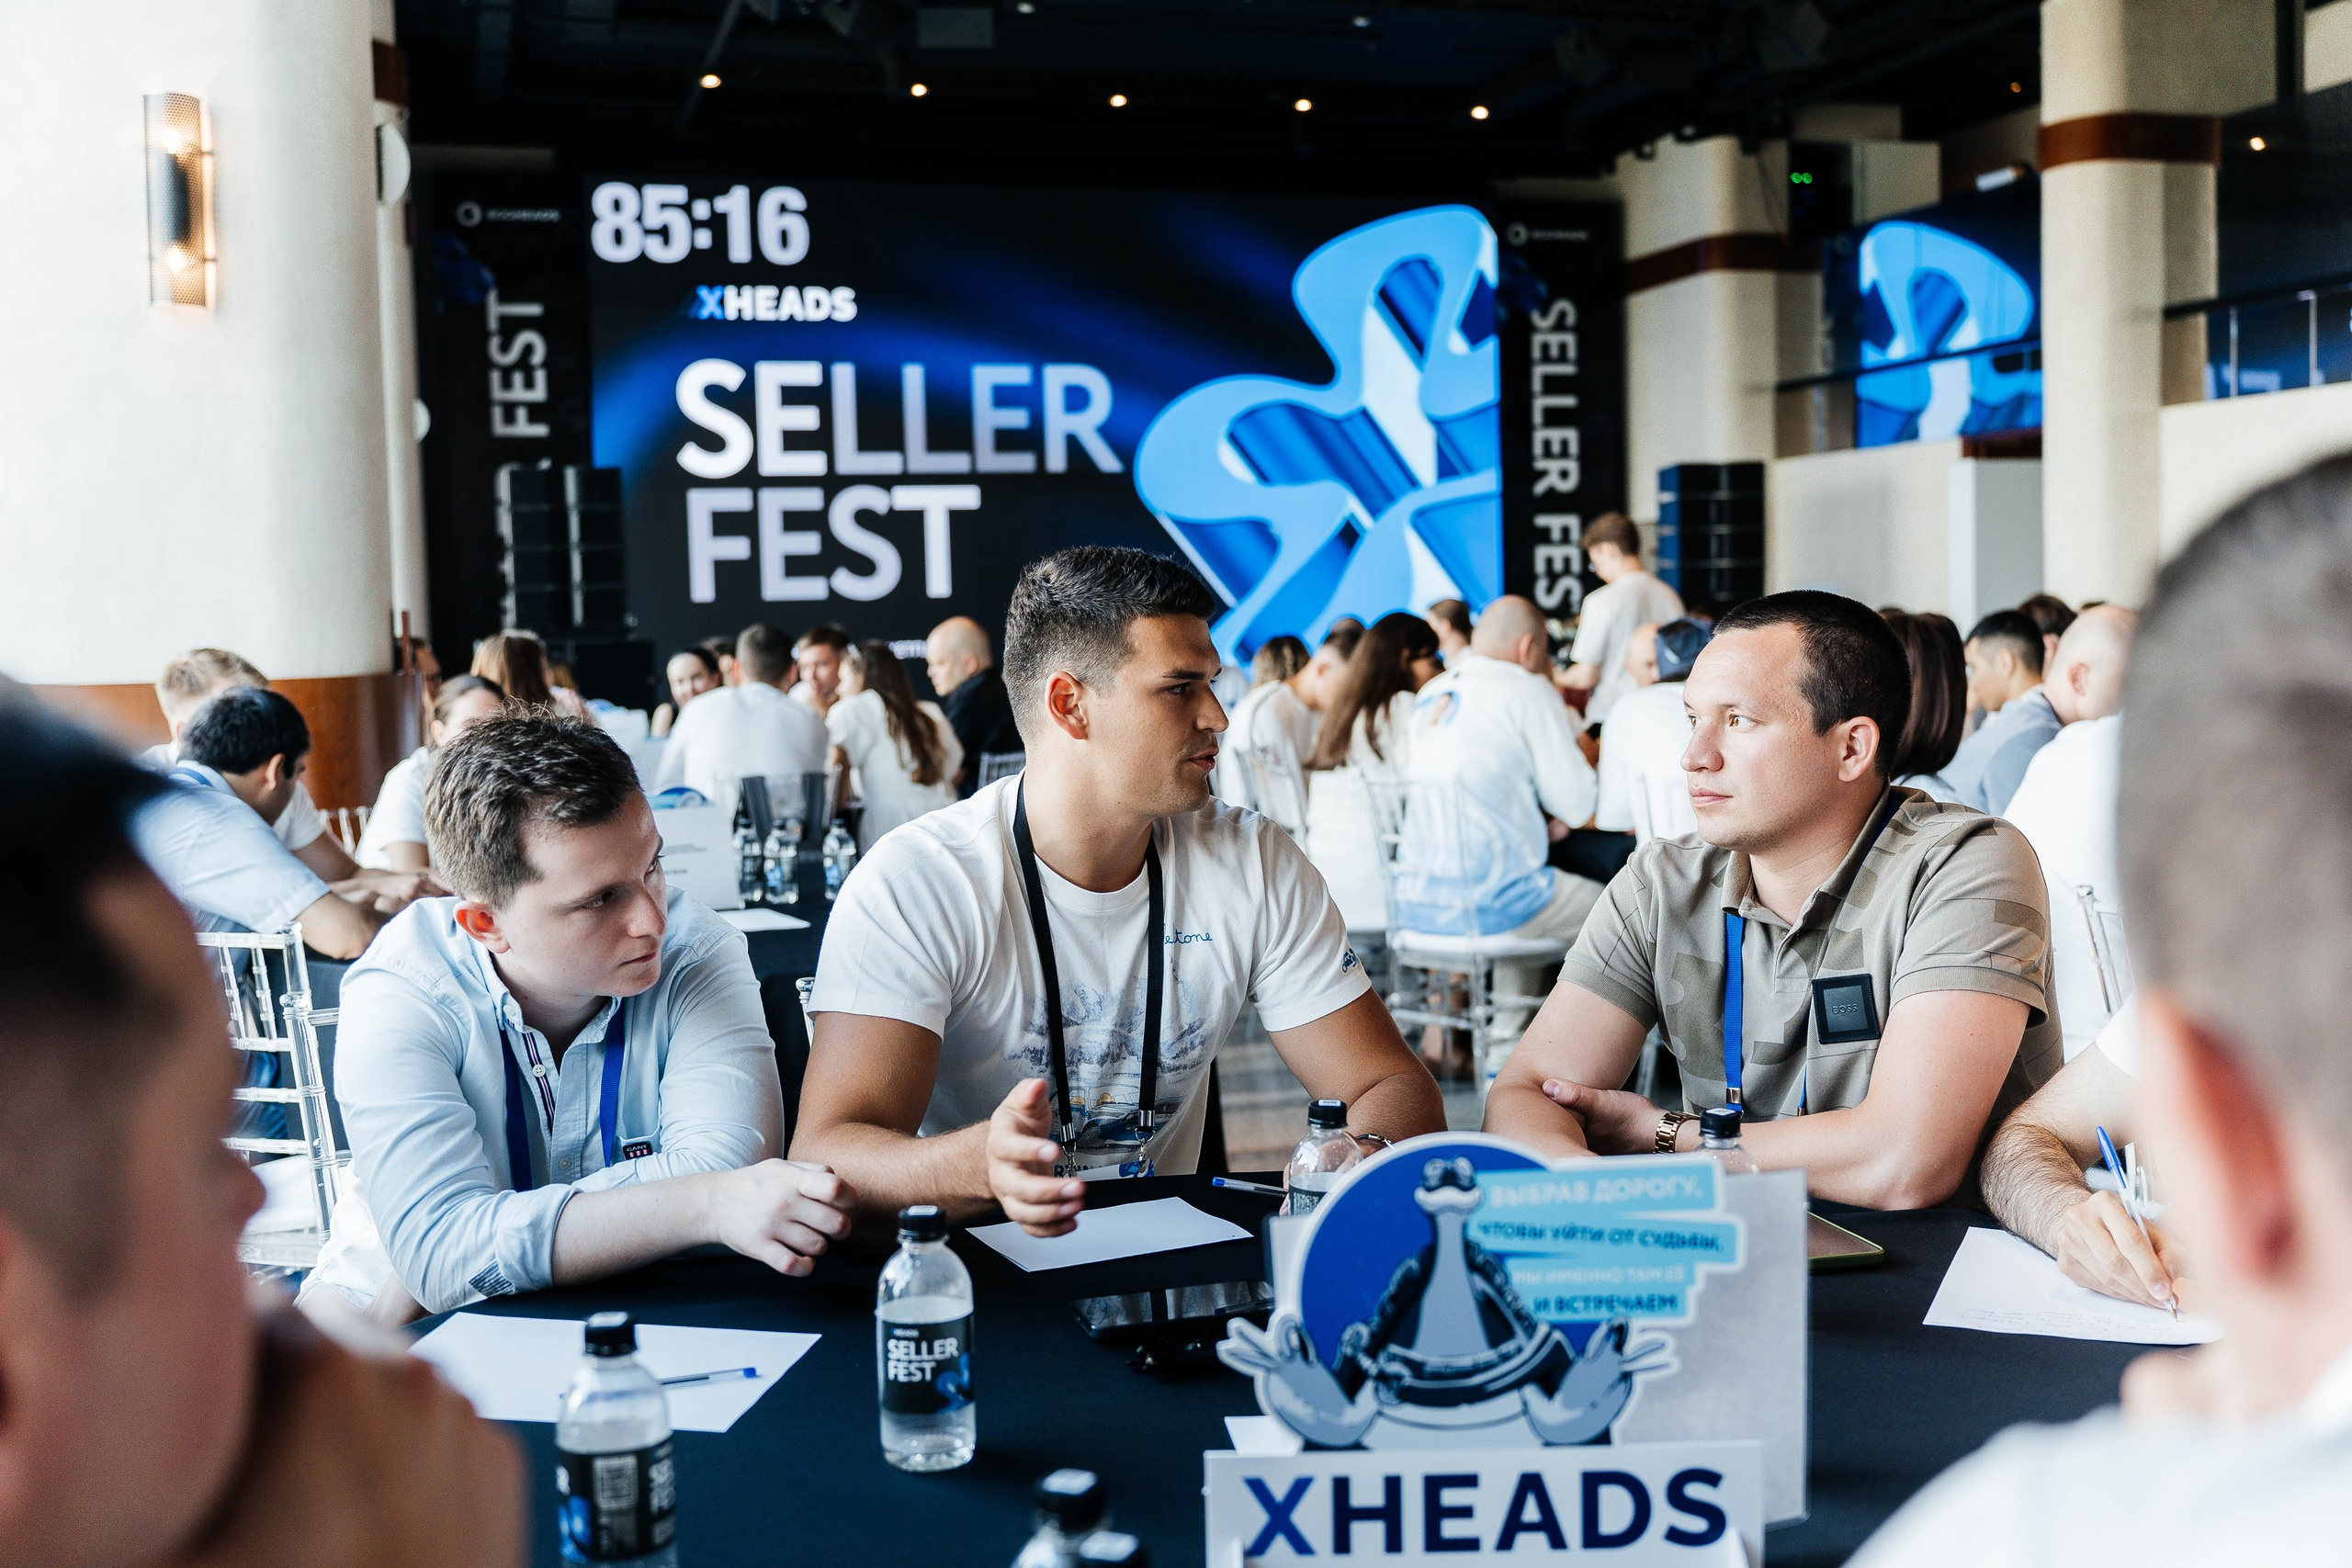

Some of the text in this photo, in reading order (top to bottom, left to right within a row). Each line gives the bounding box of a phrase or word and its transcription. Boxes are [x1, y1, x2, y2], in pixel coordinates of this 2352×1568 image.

[592, 182, 810, 265] 85:16
[695, 285, 858, 321] XHEADS
[487, 288, 549, 437] FEST
[1531, 299, 1579, 497] SELLER
[675, 358, 1125, 479] SELLER
[685, 484, 981, 603] FEST
[1532, 513, 1582, 614] FES
[1163, 928, 1213, 944] etone
[1832, 1003, 1858, 1014] BOSS
[627, 1144, 648, 1152] GANT
[1608, 1228, 1634, 1247] ОТ
[1533, 1293, 1679, 1314] И ВСТРЕЧАЕМ
[888, 1337, 959, 1361] SELLER
[888, 1359, 937, 1382] FEST
[1243, 1468, 1727, 1558] XHEADS
